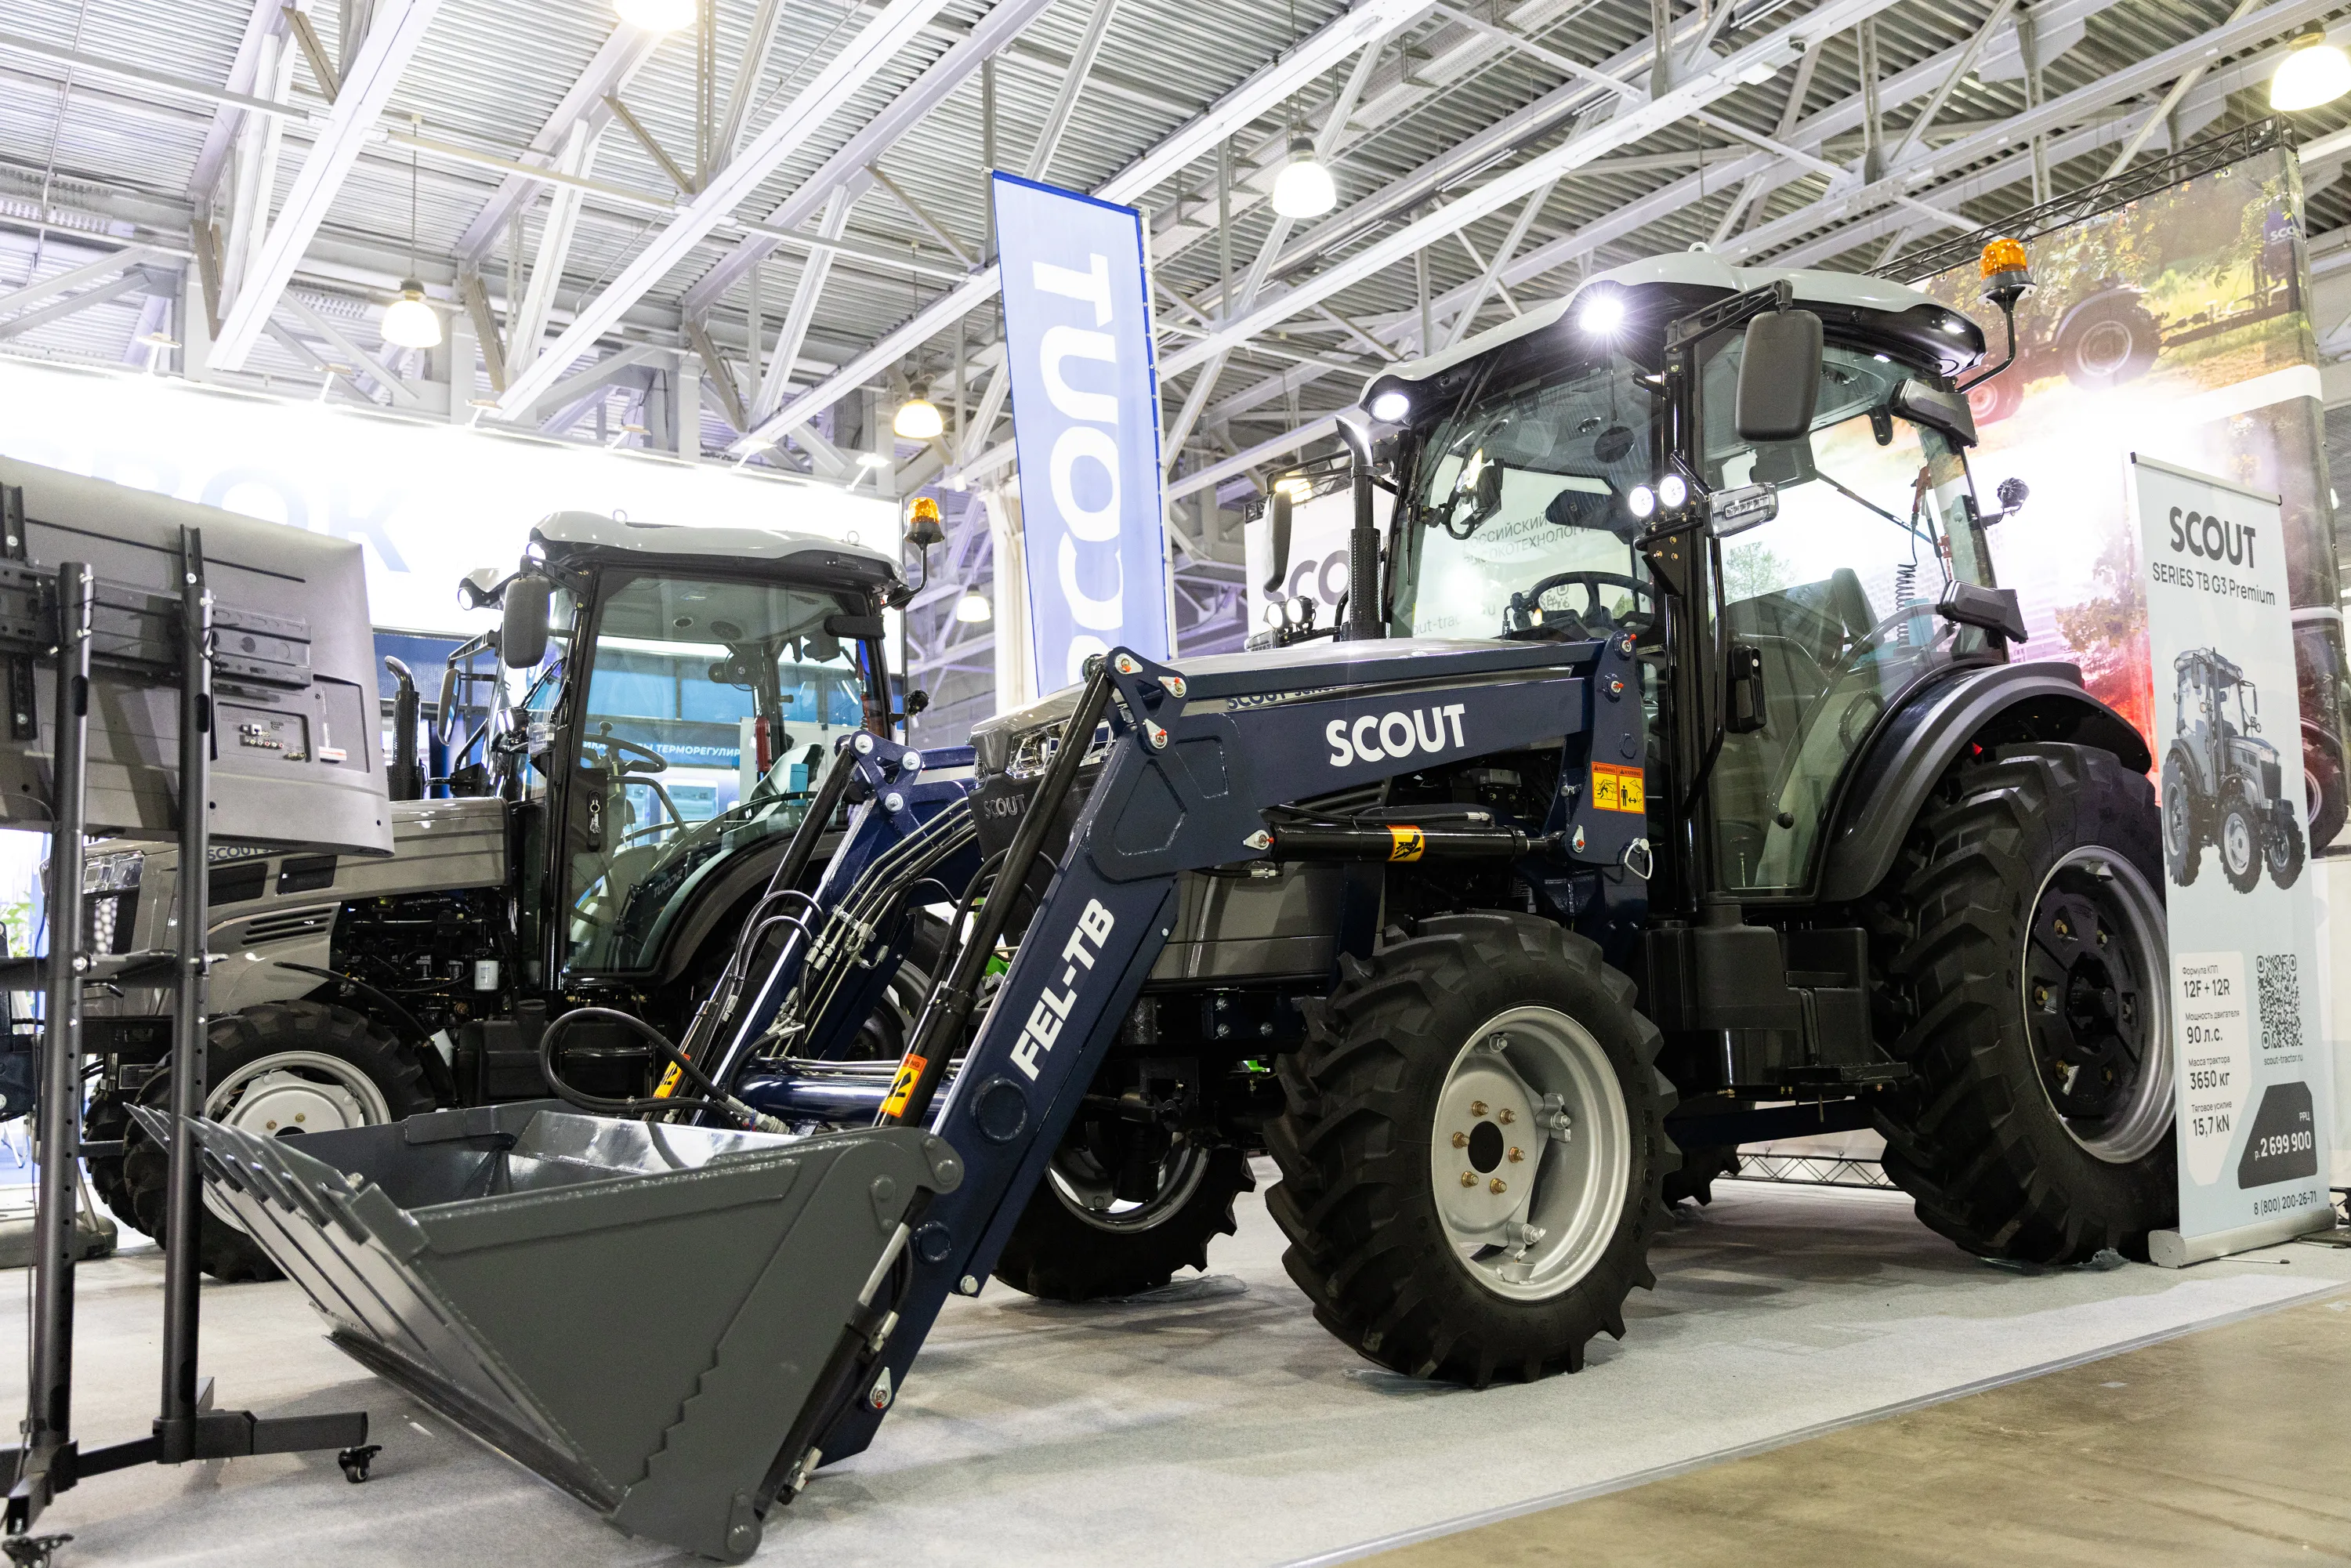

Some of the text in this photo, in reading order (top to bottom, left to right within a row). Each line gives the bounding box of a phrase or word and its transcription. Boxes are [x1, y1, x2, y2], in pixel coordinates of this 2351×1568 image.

[2169, 506, 2255, 568] SCOUT
[2153, 562, 2275, 606] SERIES TB G3 Premium
[1326, 704, 1465, 767] SCOUT
[984, 794, 1026, 820] SCOUT
[2182, 965, 2219, 977] Формула КПП
[1010, 898, 1114, 1081] FEL-TB
[2184, 978, 2230, 998] 12F + 12R
[2185, 1010, 2240, 1021] Мощность двигателя
[2187, 1026, 2223, 1044] 90 л.с.
[2188, 1056, 2230, 1066] Масса трактора
[2263, 1053, 2303, 1066] scout-tractor.ru
[2190, 1070, 2230, 1090] 3650 кг
[2191, 1101, 2233, 1114] Тяговое усилие
[2298, 1111, 2311, 1121] РРЦ
[2193, 1114, 2230, 1138] 15,7 kN
[2269, 1134, 2289, 1156] 699
[2291, 1130, 2311, 1152] 900
[2254, 1190, 2317, 1216] 8 (800) 200-26-71
